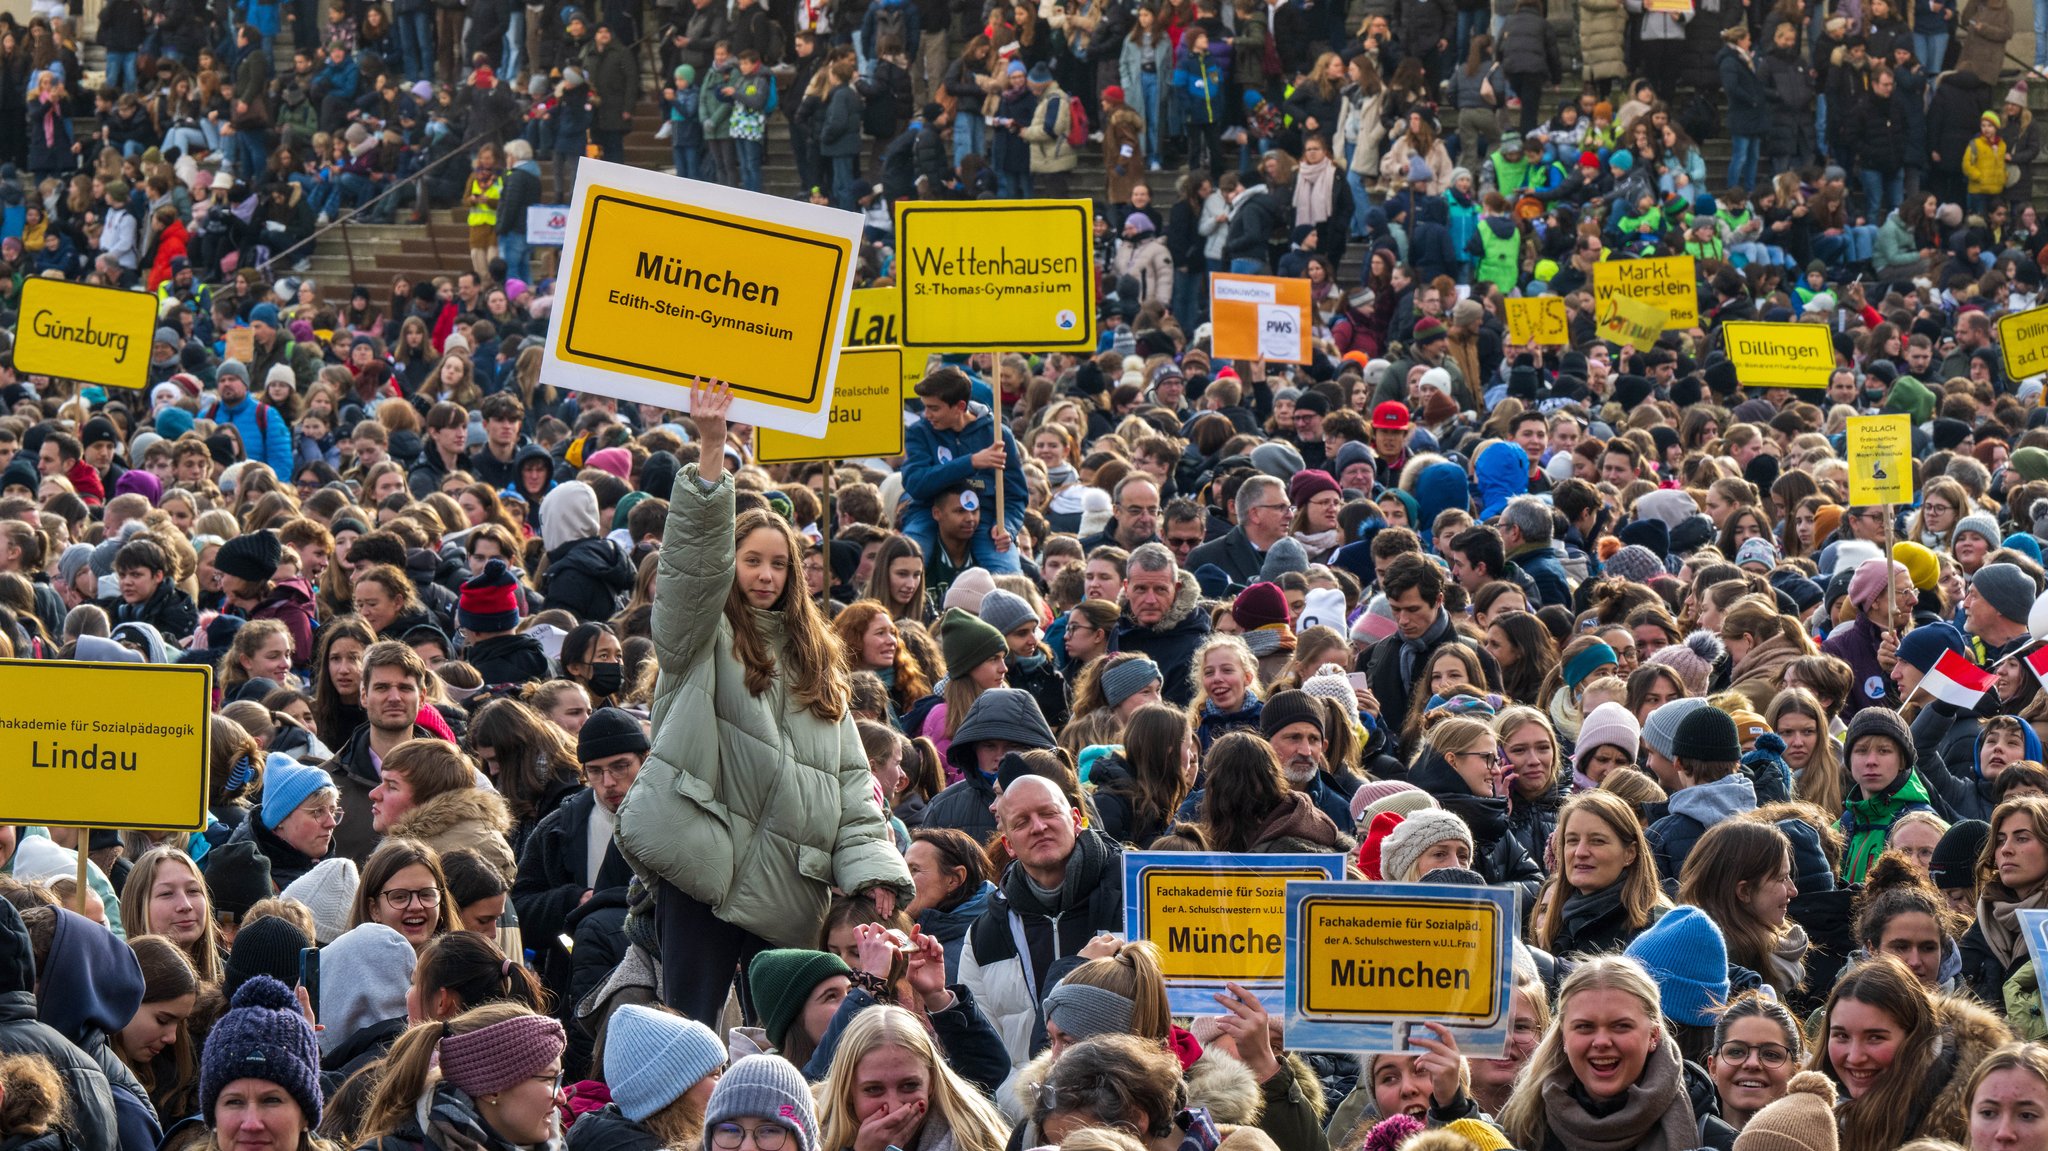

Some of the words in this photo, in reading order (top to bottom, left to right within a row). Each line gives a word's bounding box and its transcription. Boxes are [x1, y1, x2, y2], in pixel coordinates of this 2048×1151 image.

[912, 246, 1077, 276] Wettenhausen
[635, 251, 779, 306] München
[1618, 262, 1671, 281] Markt
[914, 281, 1072, 300] St.-Thomas-Gymnasium
[608, 289, 793, 341] Edith-Stein-Gymnasium
[1670, 309, 1694, 321] Ries
[1266, 320, 1292, 334] PWS
[33, 309, 129, 364] Günzburg
[1739, 340, 1819, 360] Dillingen
[834, 386, 890, 397] Realschule
[829, 405, 861, 423] dau
[1861, 425, 1896, 433] PULLACH
[71, 720, 89, 732] für
[92, 721, 195, 738] Sozialpädagogik
[32, 741, 137, 771] Lindau
[1156, 886, 1233, 897] Fachakademie
[1236, 886, 1253, 897] für
[1162, 905, 1176, 913] der
[1178, 905, 1187, 914] A.
[1189, 905, 1261, 914] Schulschwestern
[1319, 916, 1402, 929] Fachakademie
[1405, 917, 1423, 929] für
[1425, 918, 1482, 933] Sozialpäd.
[1324, 936, 1340, 945] der
[1342, 936, 1352, 945] A.
[1354, 936, 1431, 947] Schulschwestern
[1433, 939, 1477, 949] v.U.L.Frau
[1330, 959, 1470, 990] München
